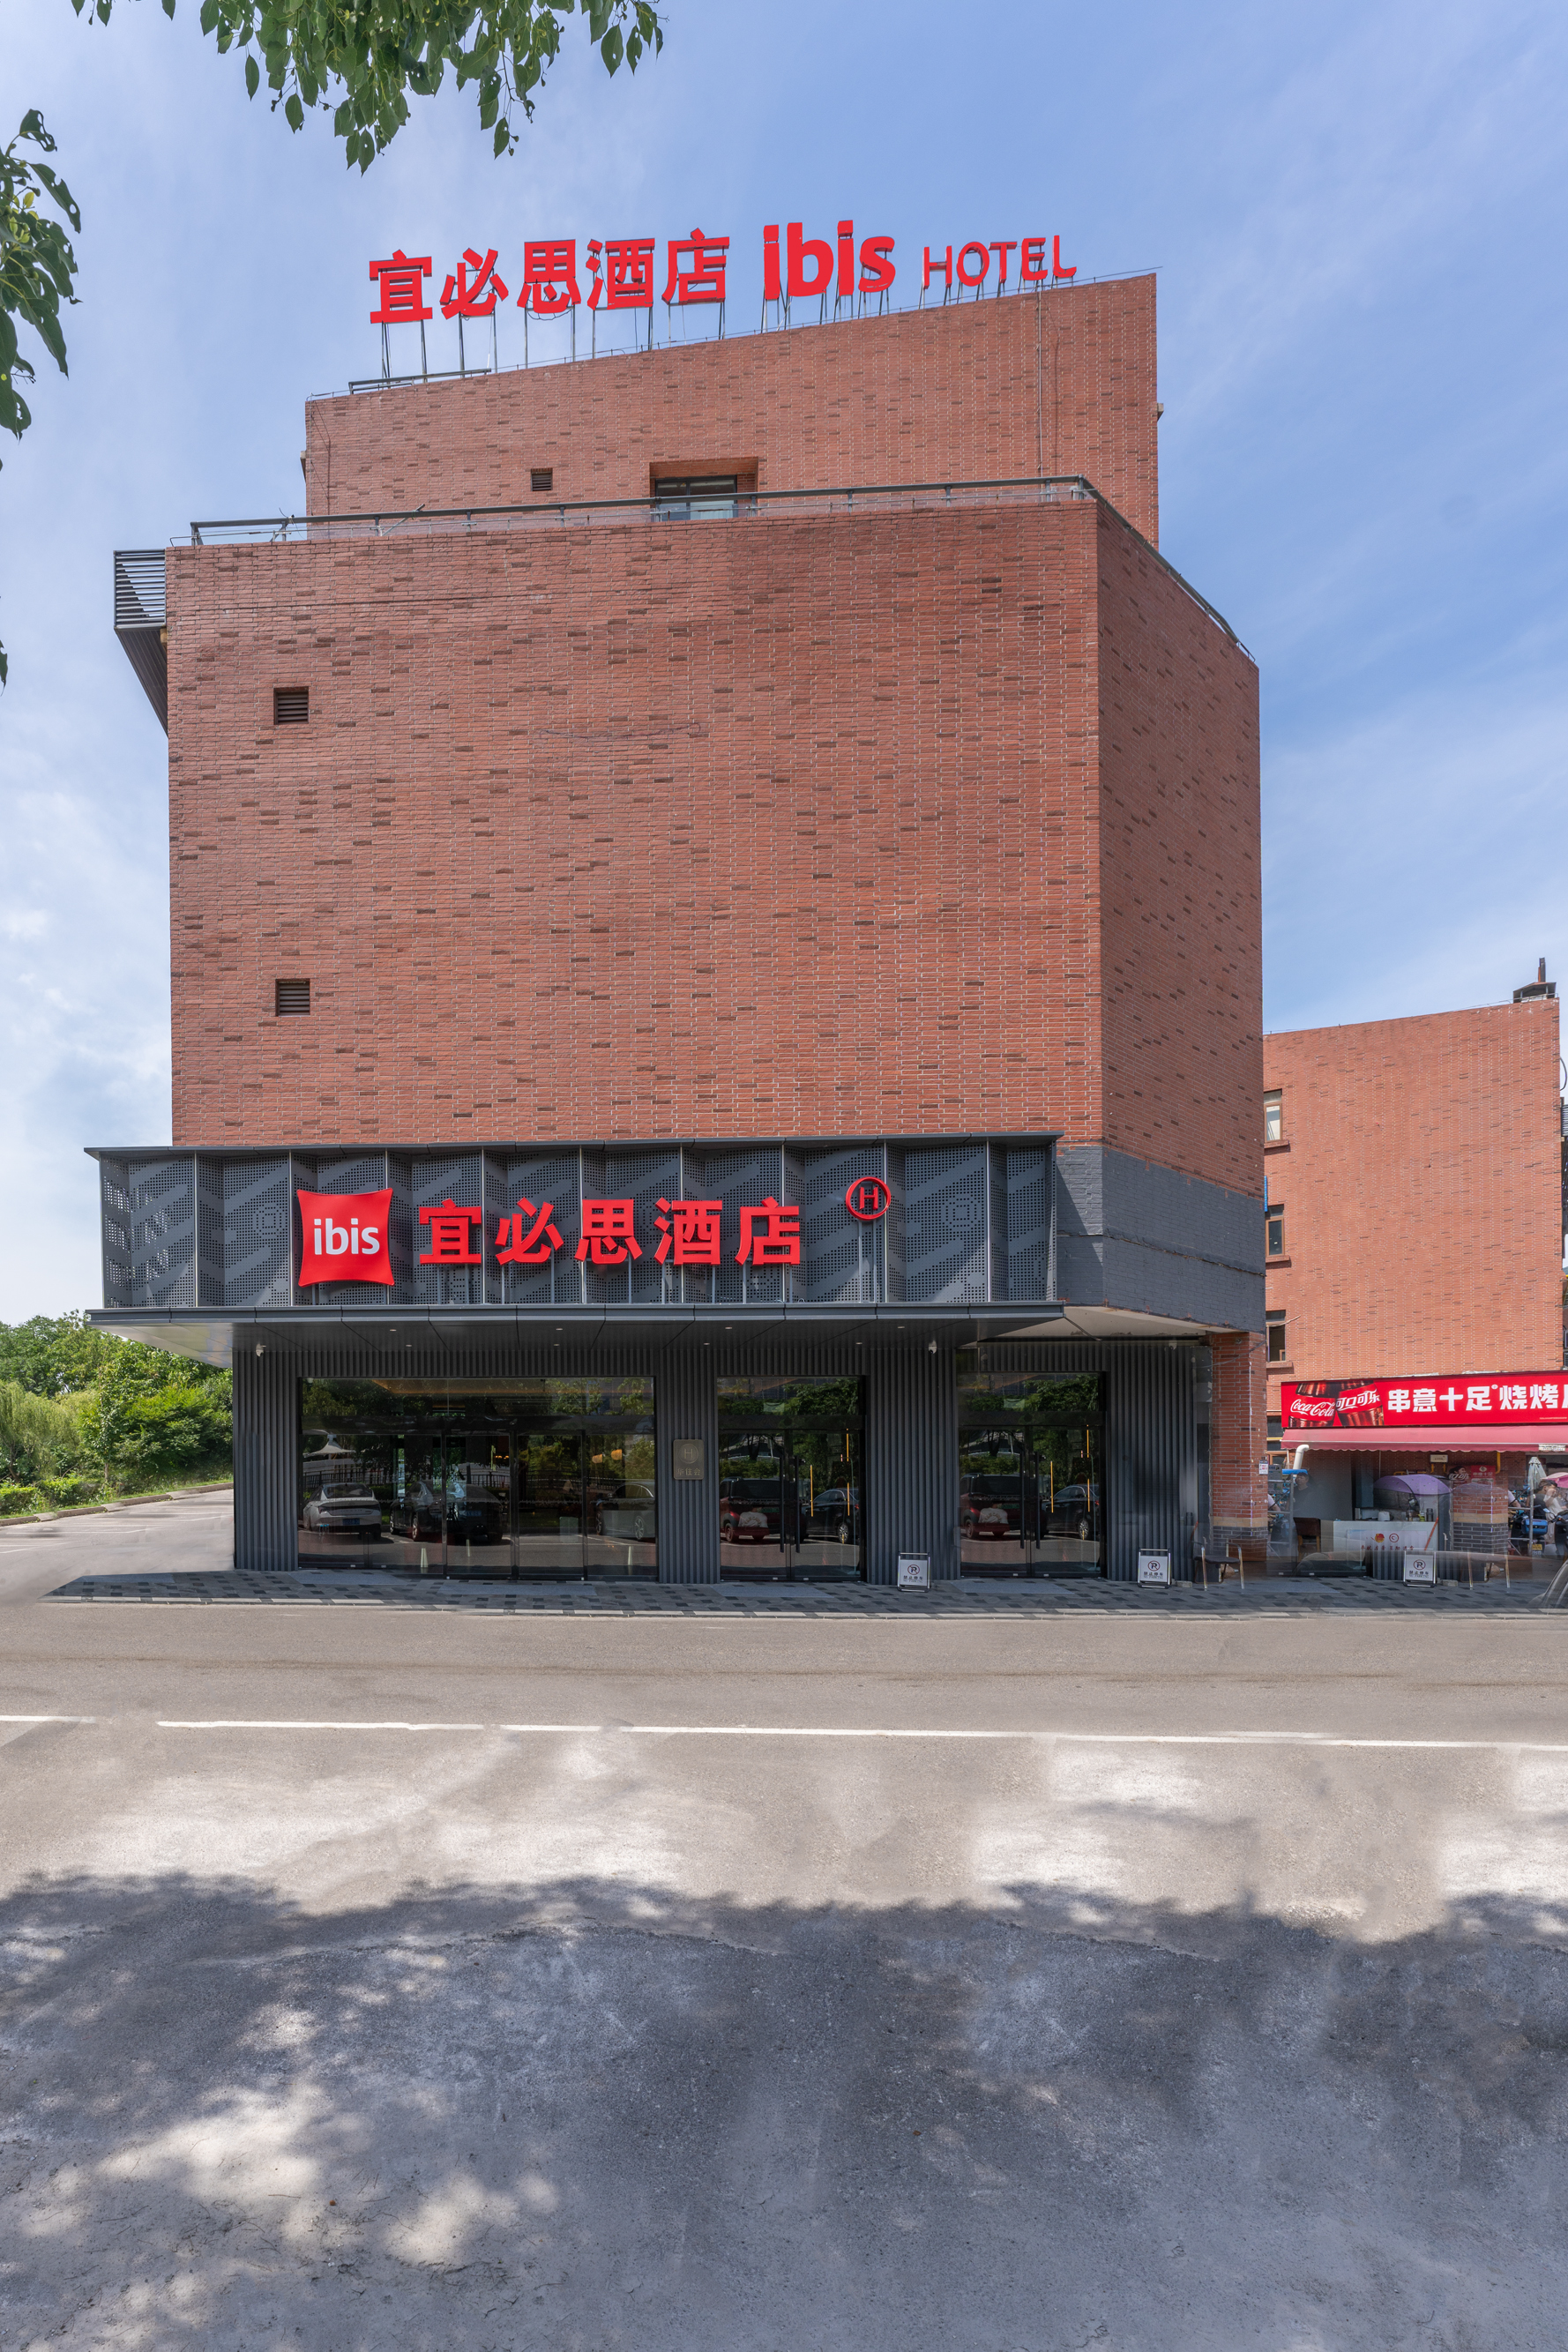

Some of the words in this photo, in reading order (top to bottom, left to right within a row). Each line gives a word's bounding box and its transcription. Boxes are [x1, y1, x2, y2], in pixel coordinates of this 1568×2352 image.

[370, 228, 730, 324] 宜必思酒店
[763, 220, 896, 302] ibis
[923, 235, 1078, 288] HOTEL
[314, 1218, 380, 1256] ibis
[419, 1197, 801, 1266] 宜必思酒店
[1335, 1389, 1381, 1411] 可口可乐
[677, 1467, 701, 1476] 华住会
